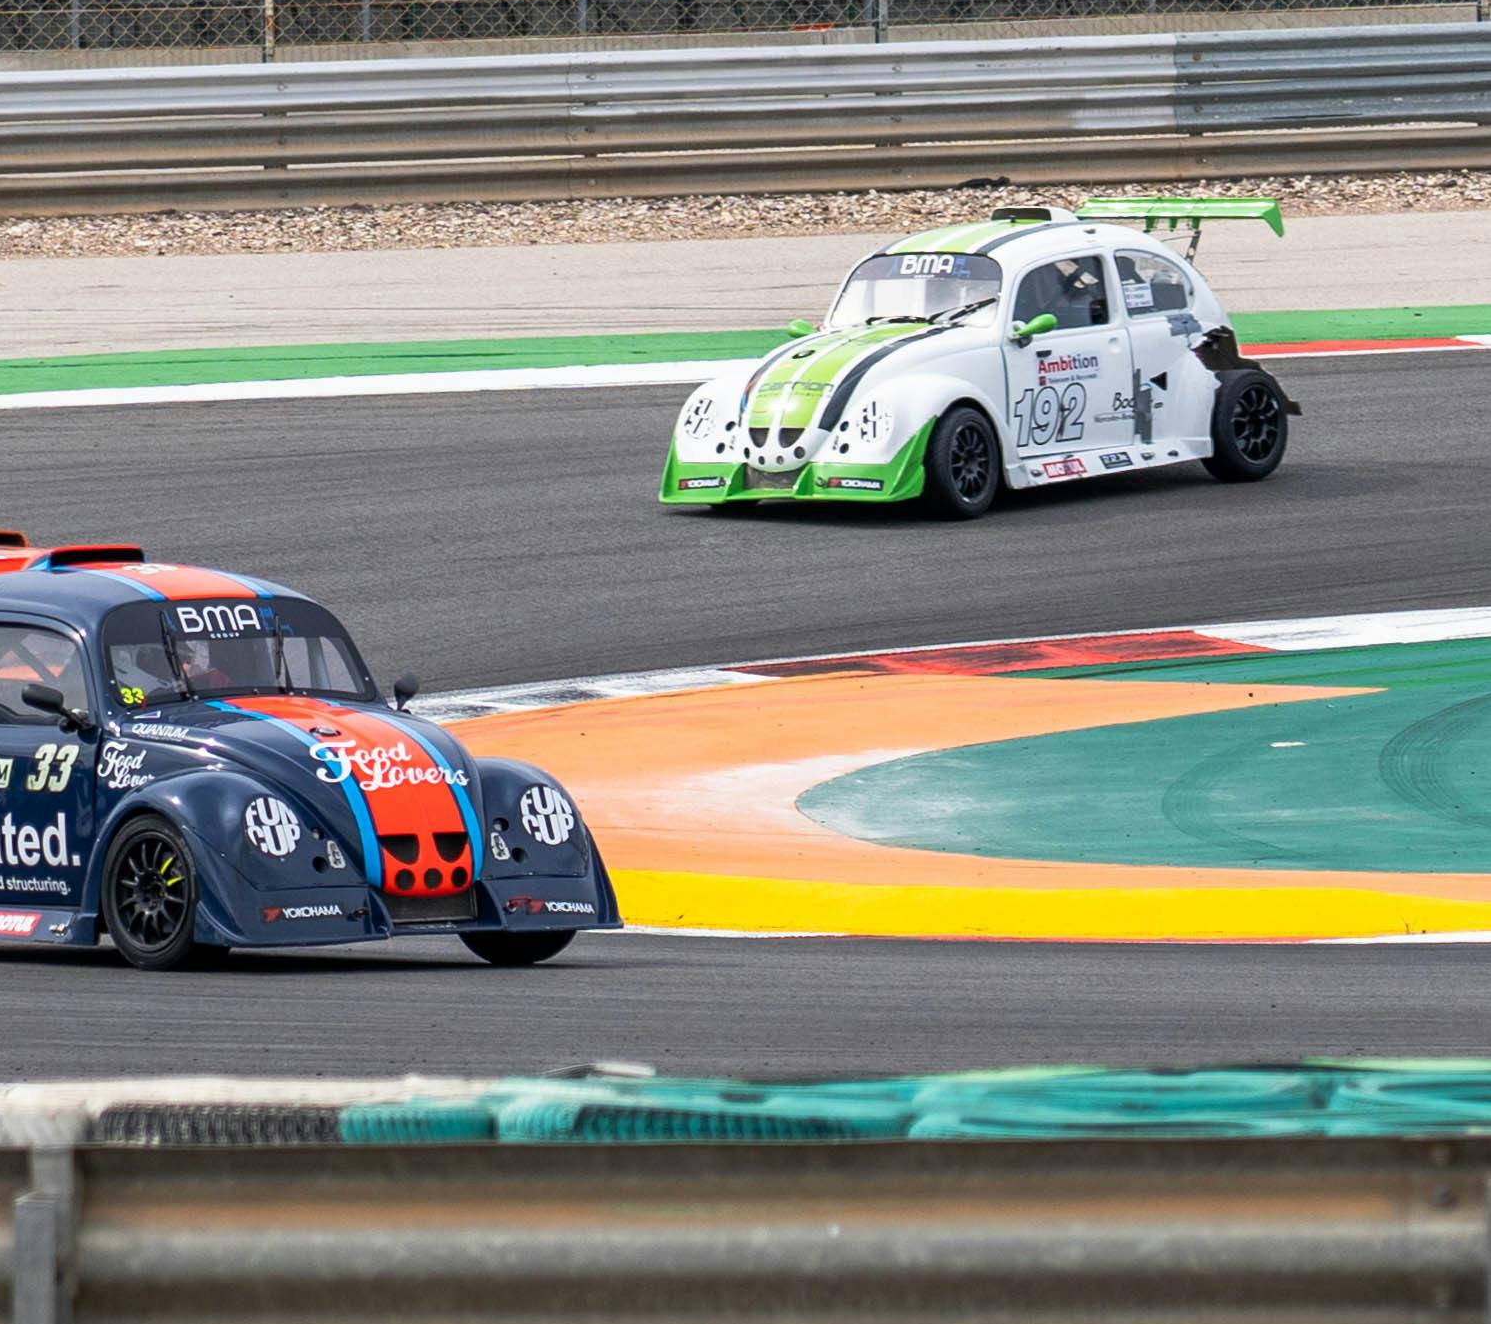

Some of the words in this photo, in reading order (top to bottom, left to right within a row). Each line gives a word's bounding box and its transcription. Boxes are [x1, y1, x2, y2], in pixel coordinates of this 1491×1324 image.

[900, 255, 955, 274] BMA
[1038, 356, 1099, 374] Ambition
[1014, 382, 1087, 447] 192
[176, 605, 261, 633] BMA
[120, 688, 145, 704] 33
[132, 723, 189, 738] QUANTUM
[26, 743, 79, 792] 33
[97, 741, 147, 777] Food
[309, 740, 412, 783] Food
[359, 758, 470, 791] Lovers
[245, 797, 299, 826] FUN
[521, 786, 573, 816] FUN
[247, 824, 301, 857] CUP
[522, 814, 575, 846] CUP
[6, 877, 71, 895] structuring.
[282, 905, 342, 918] YOKOHAMA
[545, 901, 595, 914] YOKOHAMA
